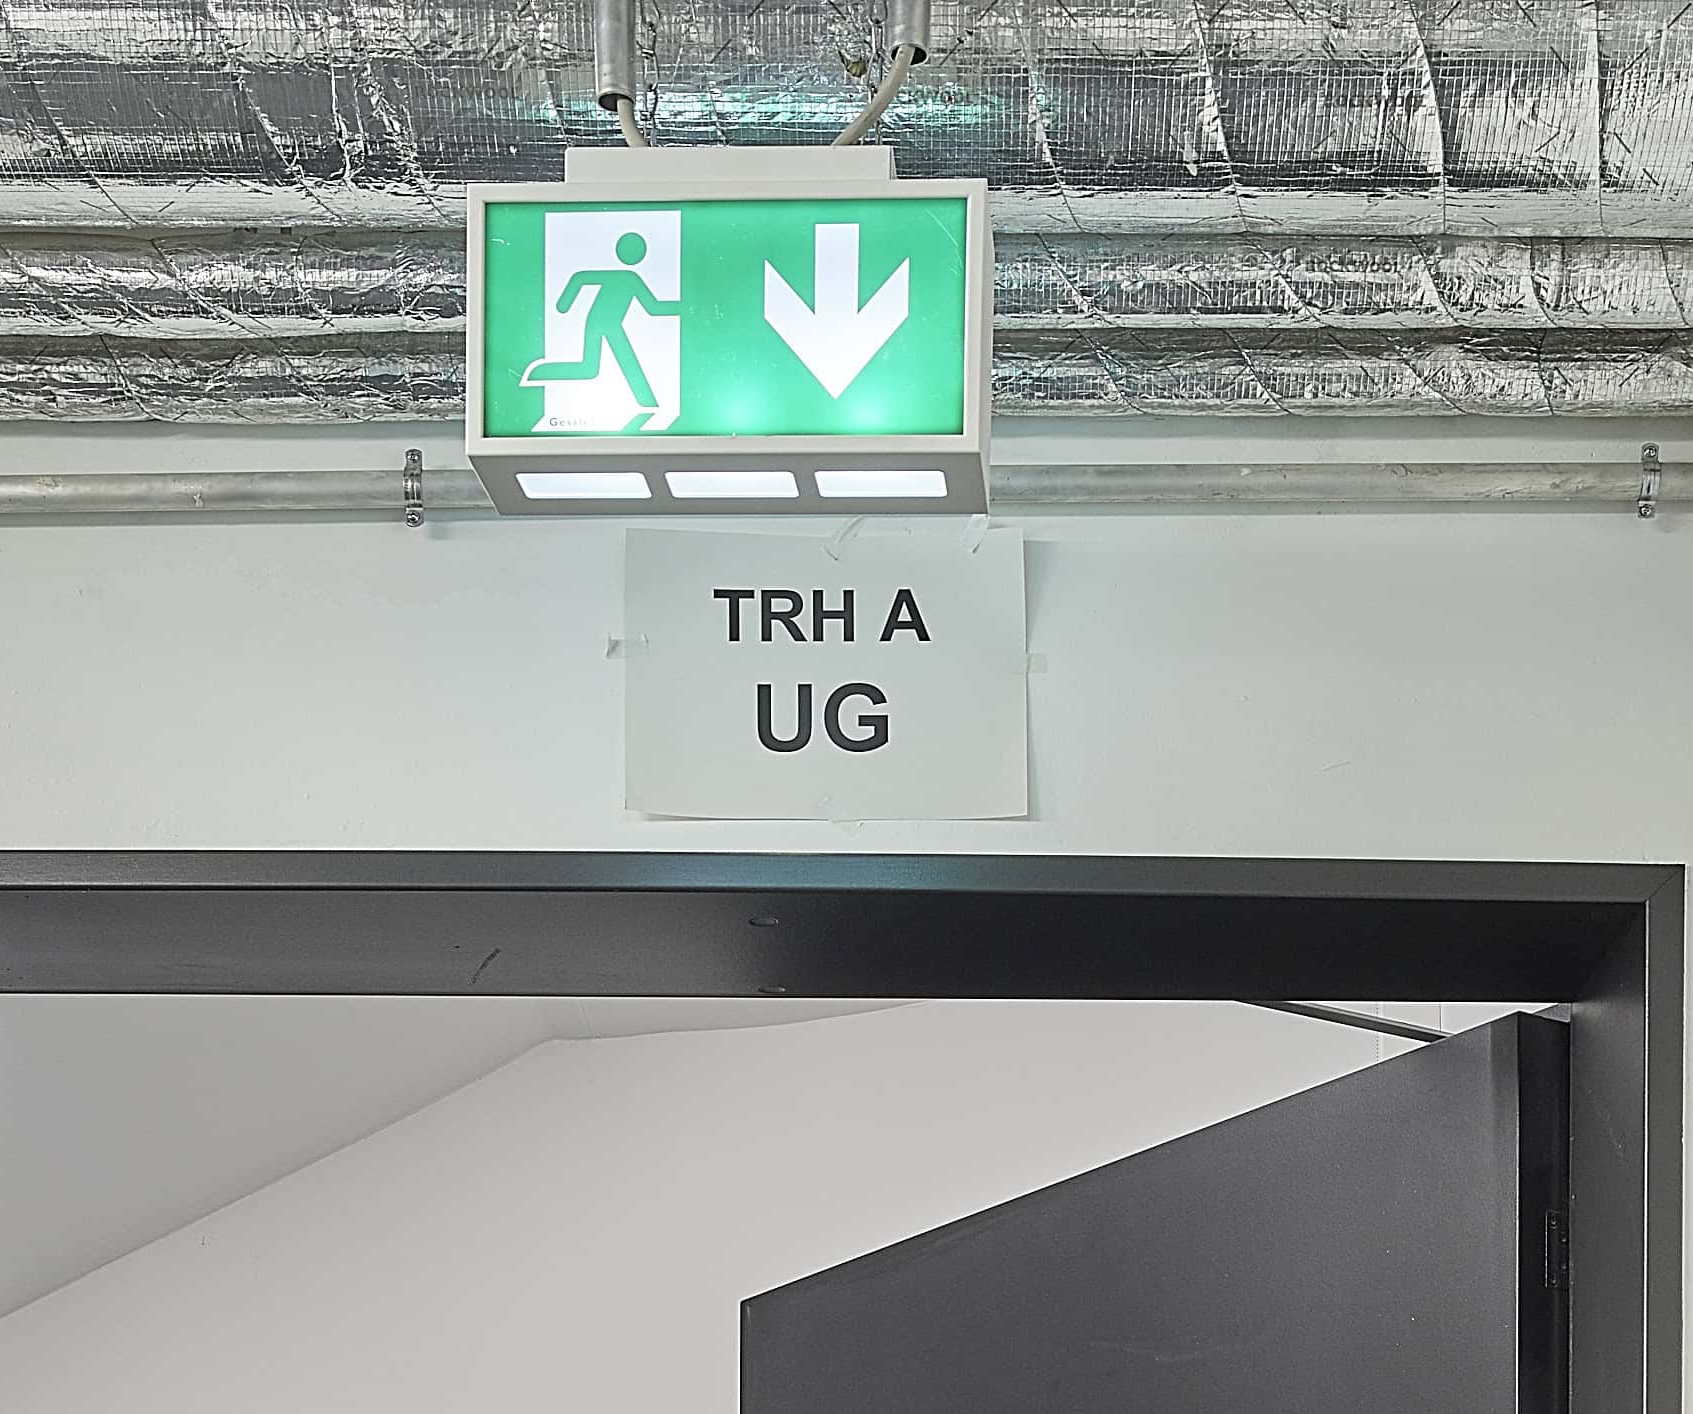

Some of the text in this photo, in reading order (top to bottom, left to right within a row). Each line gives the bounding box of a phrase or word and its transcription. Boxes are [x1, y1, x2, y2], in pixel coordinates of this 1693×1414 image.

[713, 589, 931, 643] TRH A
[756, 682, 890, 752] UG
